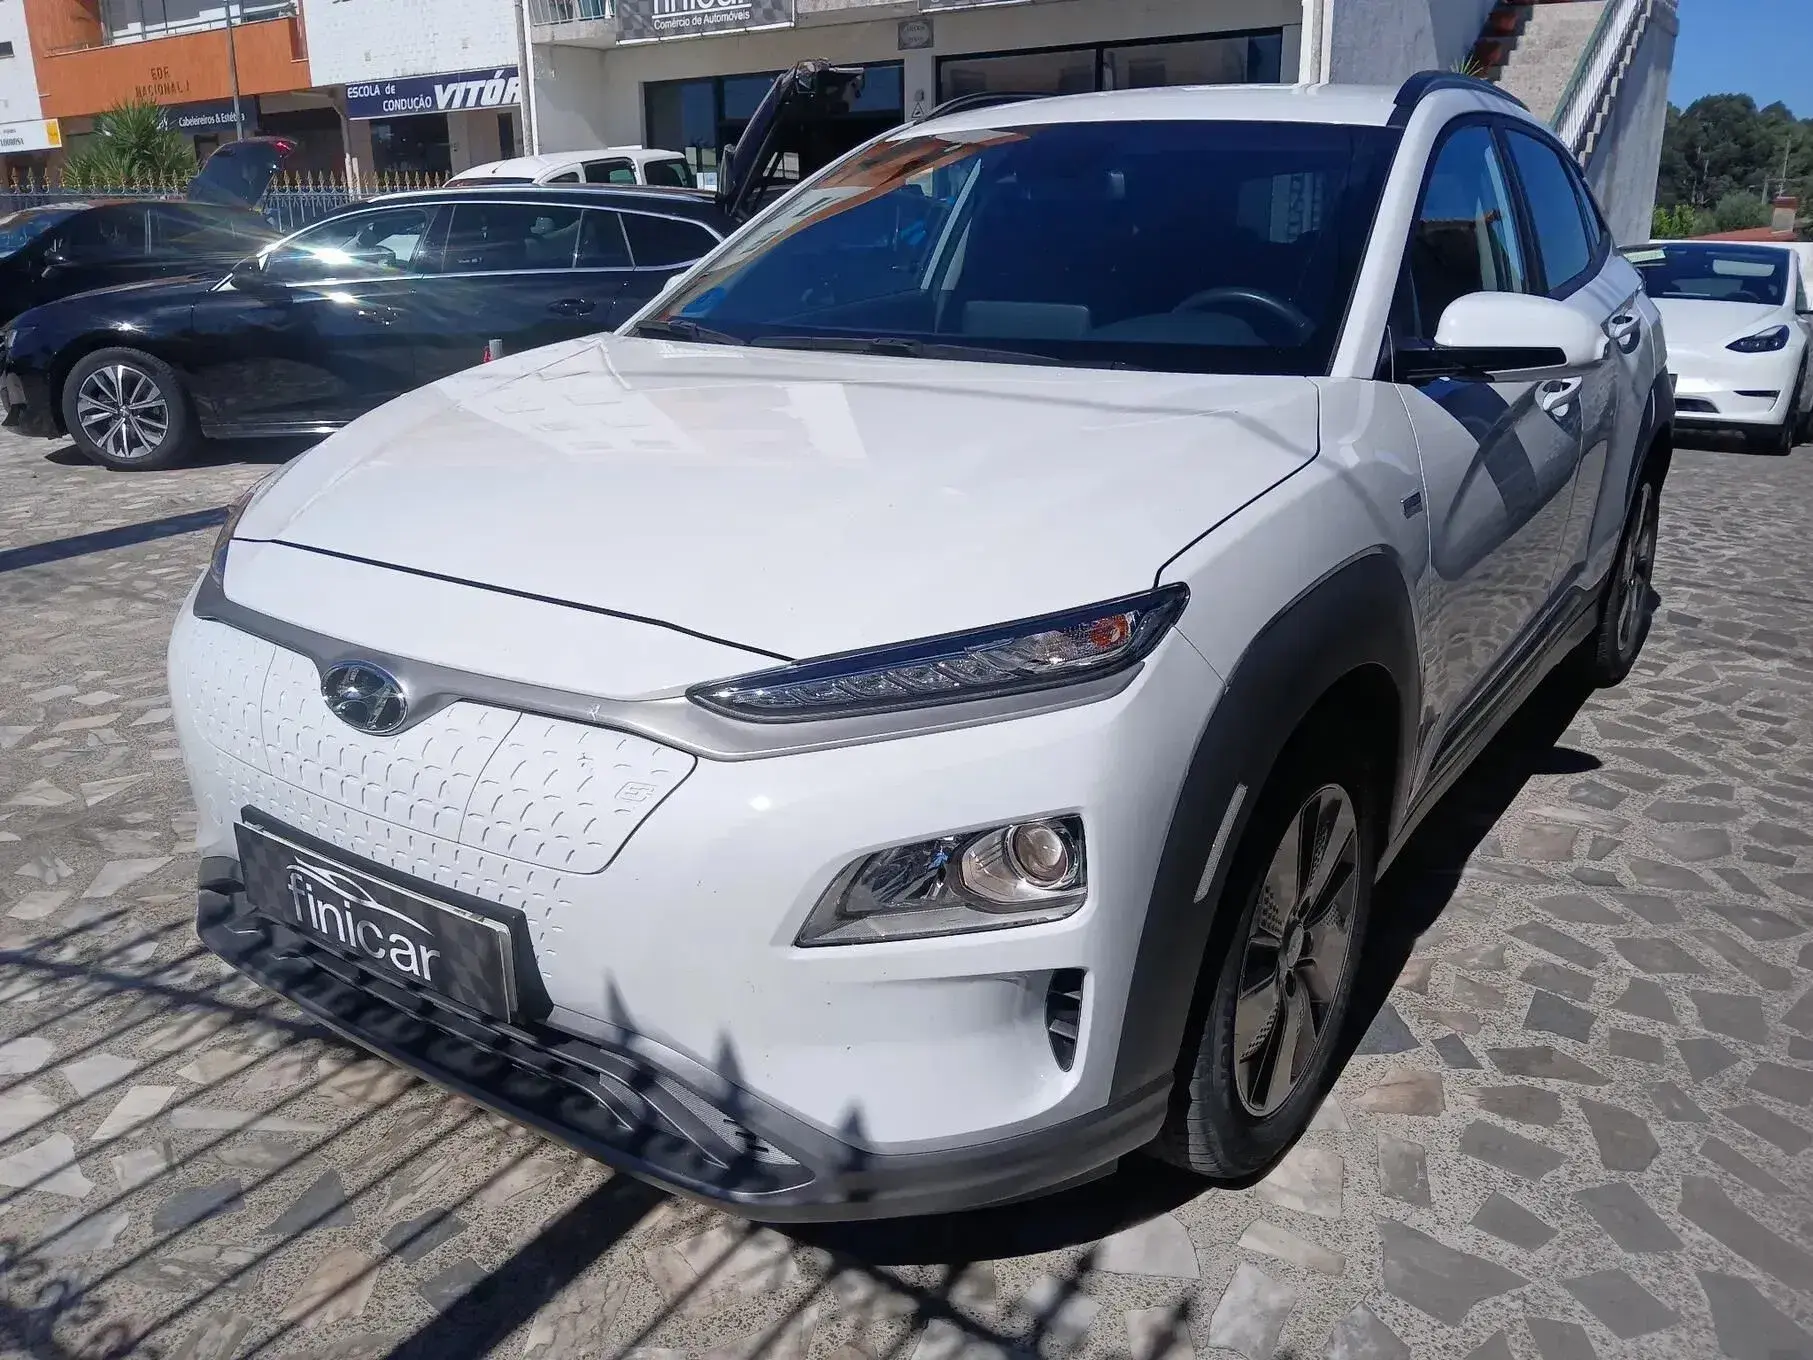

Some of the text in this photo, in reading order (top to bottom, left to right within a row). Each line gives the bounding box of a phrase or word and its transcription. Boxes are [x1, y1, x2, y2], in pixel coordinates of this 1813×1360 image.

[654, 9, 750, 30] Comércio de Automóveis
[347, 83, 396, 99] ESCOLA de
[383, 93, 432, 112] CONDUÇÃO
[178, 114, 215, 127] Cabeleireiros
[215, 113, 221, 123] &
[287, 871, 440, 982] finicar
